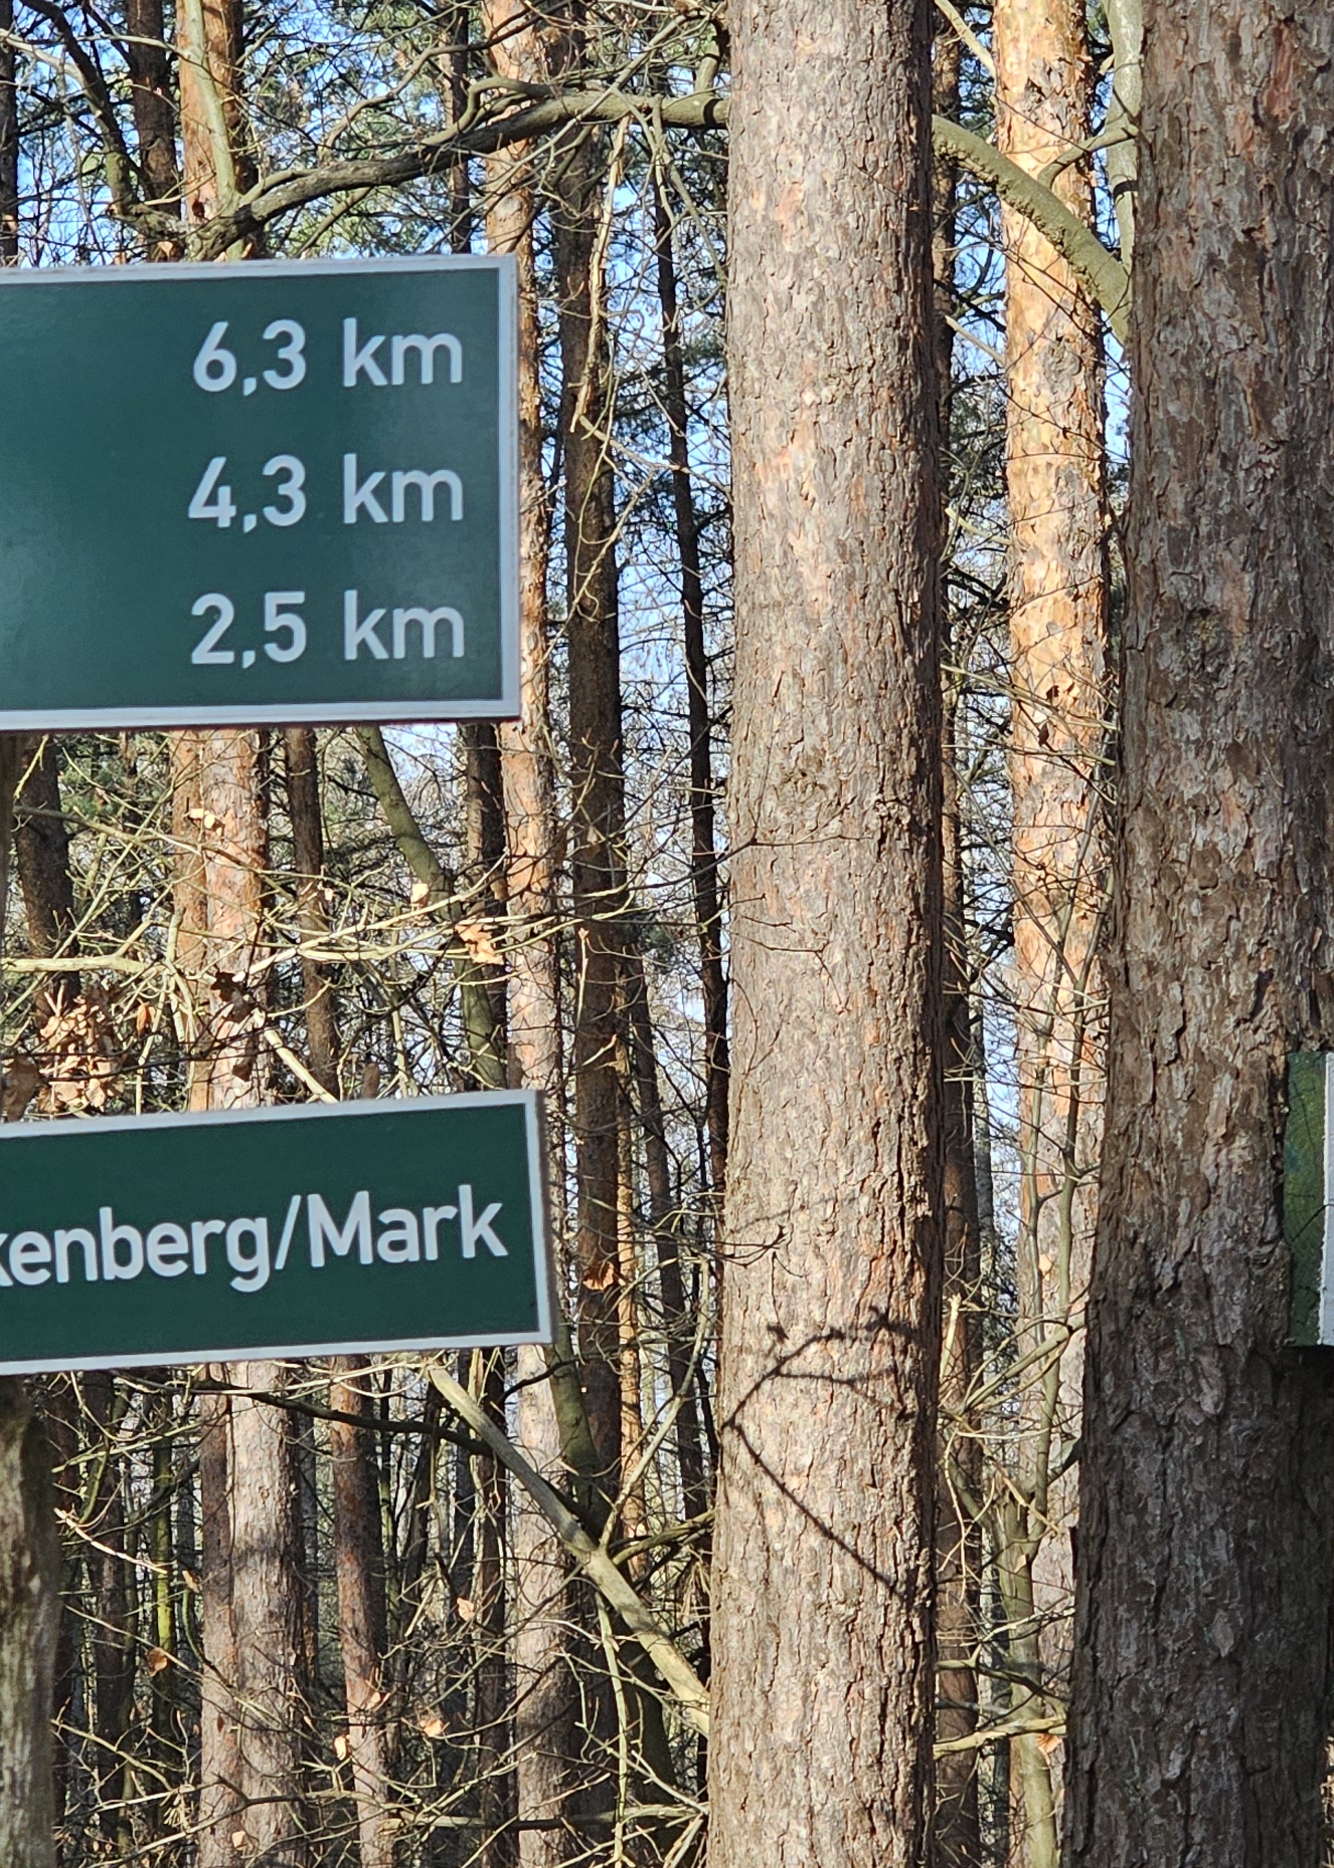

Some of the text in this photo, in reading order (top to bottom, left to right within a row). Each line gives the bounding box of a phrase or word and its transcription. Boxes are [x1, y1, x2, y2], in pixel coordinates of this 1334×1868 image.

[193, 319, 307, 397] 6,3
[343, 317, 463, 388] km
[188, 454, 307, 533] 4,3
[343, 452, 464, 525] km
[190, 590, 307, 670] 2,5
[344, 589, 466, 661] km
